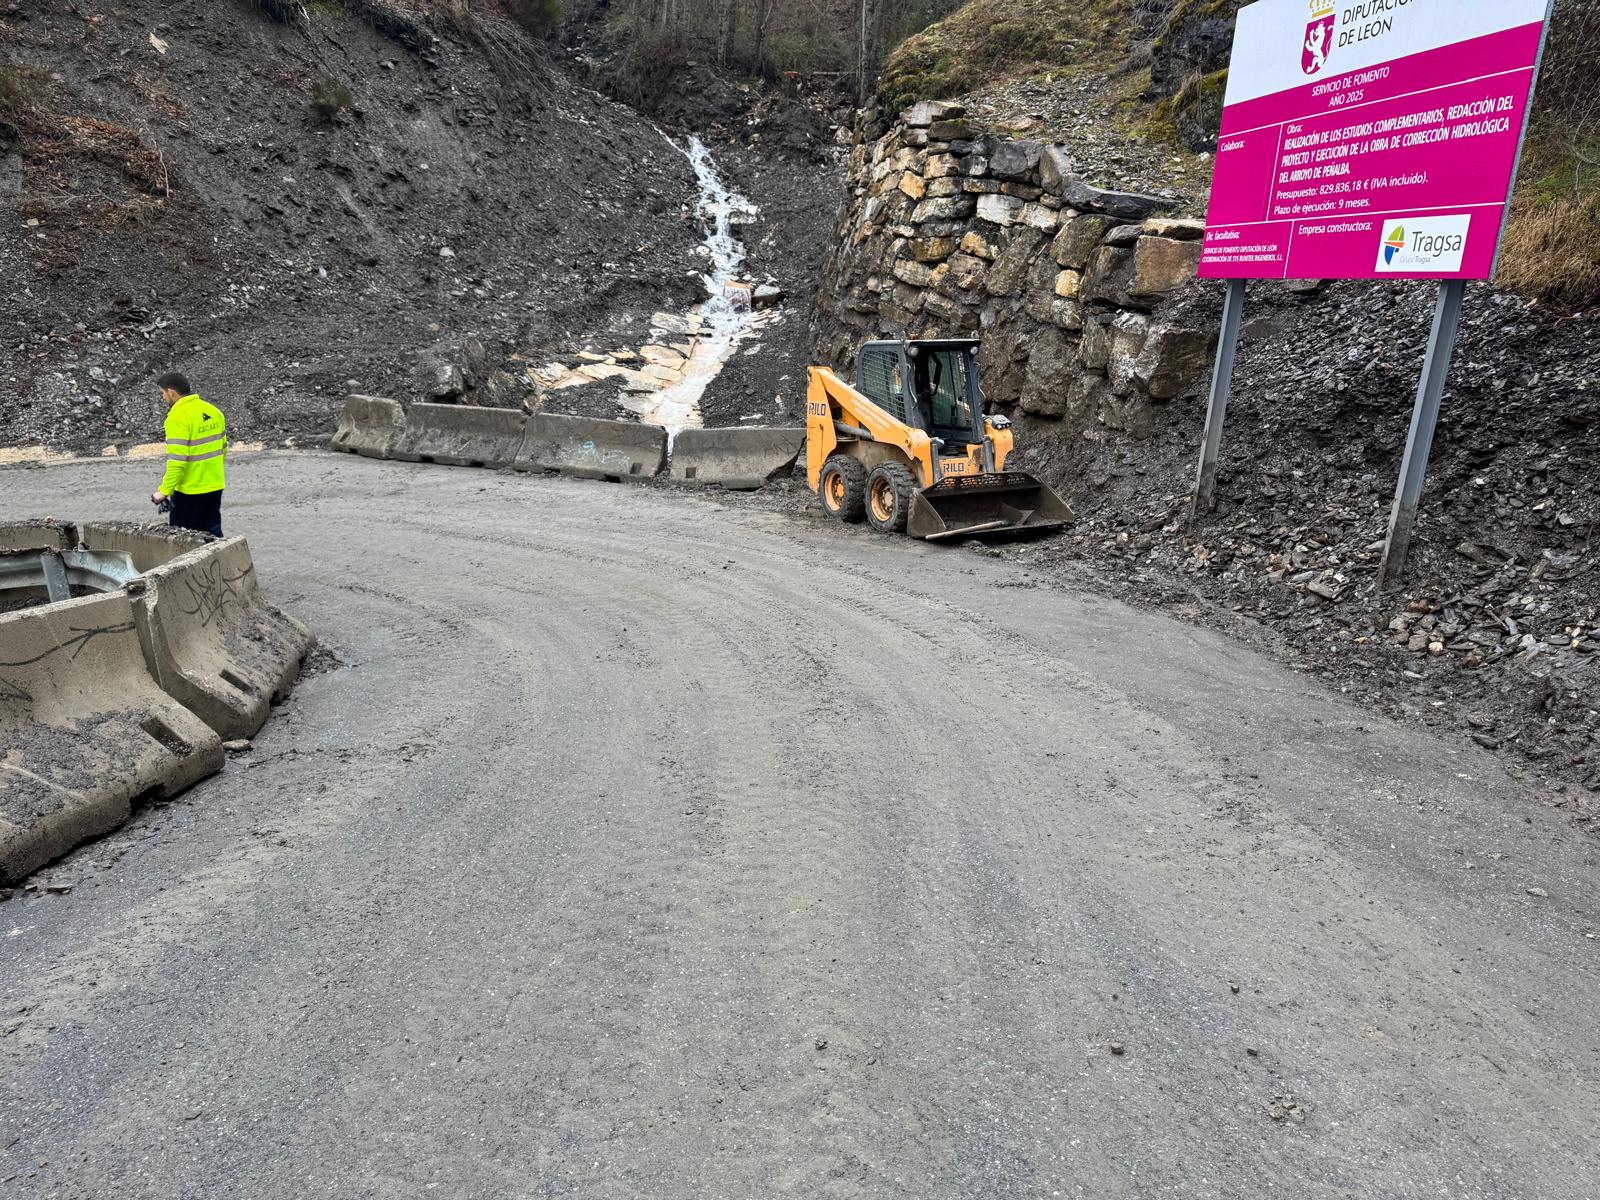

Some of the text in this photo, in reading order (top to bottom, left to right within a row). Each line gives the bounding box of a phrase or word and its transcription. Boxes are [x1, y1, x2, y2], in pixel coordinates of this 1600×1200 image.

[1342, 0, 1413, 25] DIPUTACI
[1338, 16, 1393, 47] DE LEÓN
[1311, 66, 1390, 97] SERVICIO DE FOMENTO
[1328, 89, 1364, 107] AÑO 2025
[1283, 95, 1514, 151] REALIZACIÓN DE LOS ESTUDIOS COMPLEMENTARIOS, REDACCIÓN DEL
[1286, 123, 1303, 135] Obra:
[1220, 140, 1246, 152] Colabora:
[1280, 115, 1510, 168] PROYECTO Y EJECUCIÓN DE LA OBRA DE CORRECCIÓN HIDROLÓGICA
[1278, 161, 1351, 184] DEL ARROYO DE PEÑALBA.
[1276, 170, 1429, 200] Presupuesto: 829.836,18 € (IVA incluido).
[1273, 198, 1371, 215] Plazo de ejecución: 9 meses.
[1298, 221, 1373, 236] Empresa constructora:
[1412, 231, 1462, 257] Tragsa
[808, 402, 826, 416] RILO
[943, 462, 965, 473] RILO
